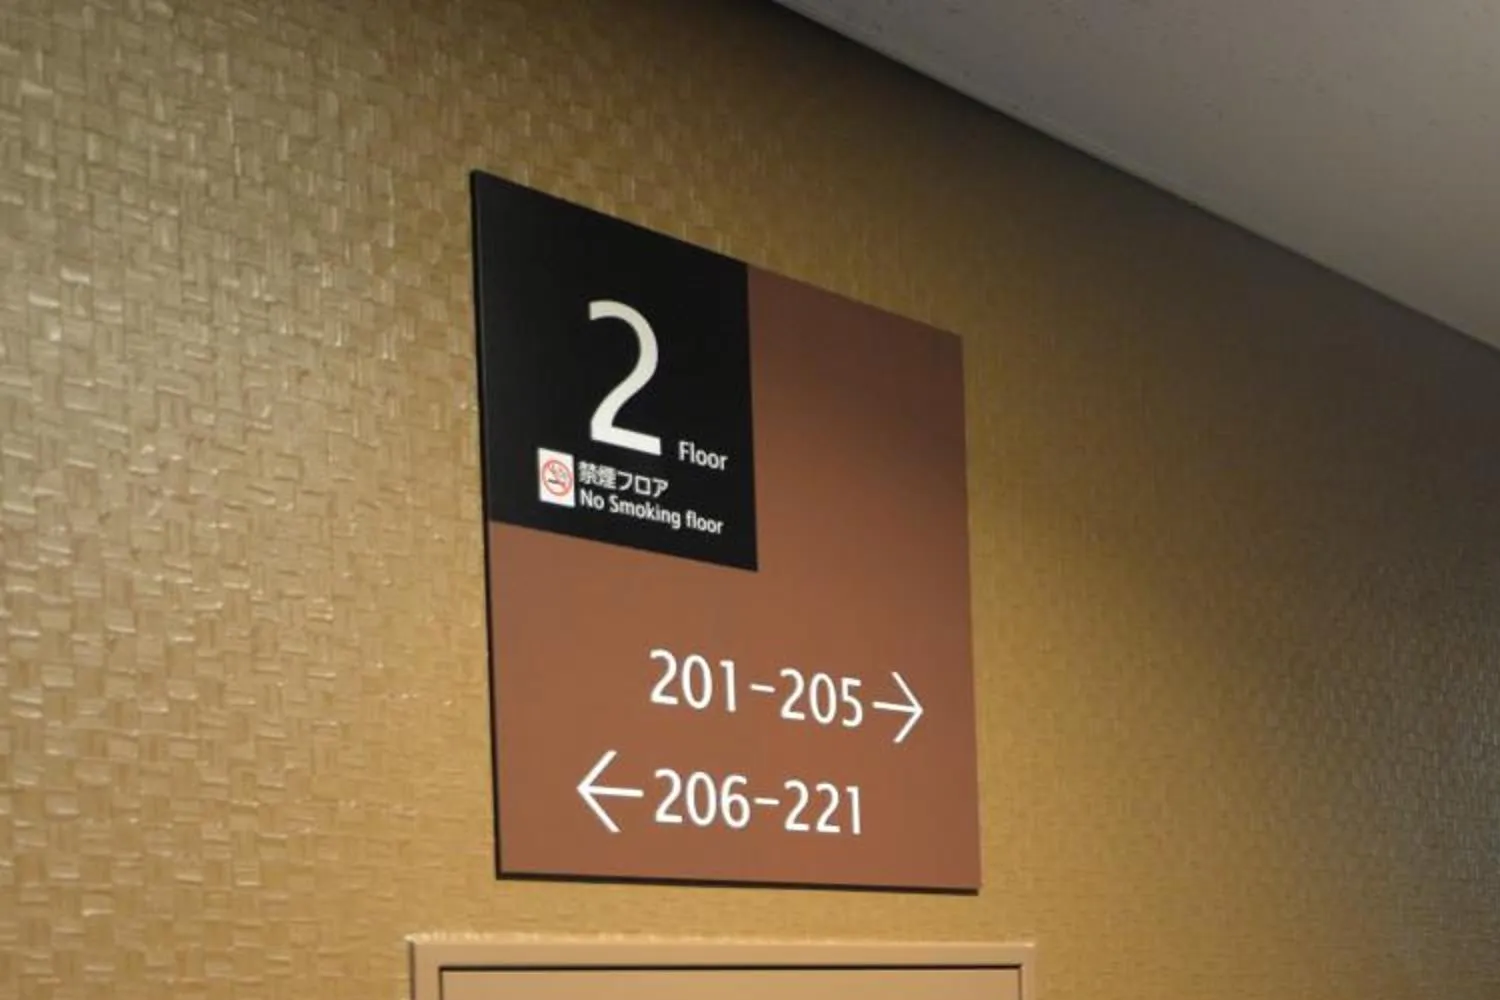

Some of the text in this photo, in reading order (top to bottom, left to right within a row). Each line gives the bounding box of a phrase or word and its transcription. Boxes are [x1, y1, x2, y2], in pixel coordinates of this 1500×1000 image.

[588, 299, 728, 471] 2 Floor
[577, 459, 670, 499] 禁煙フロア
[579, 487, 724, 535] No Smoking floor
[649, 647, 865, 728] 201-205
[653, 767, 862, 836] 206-221
